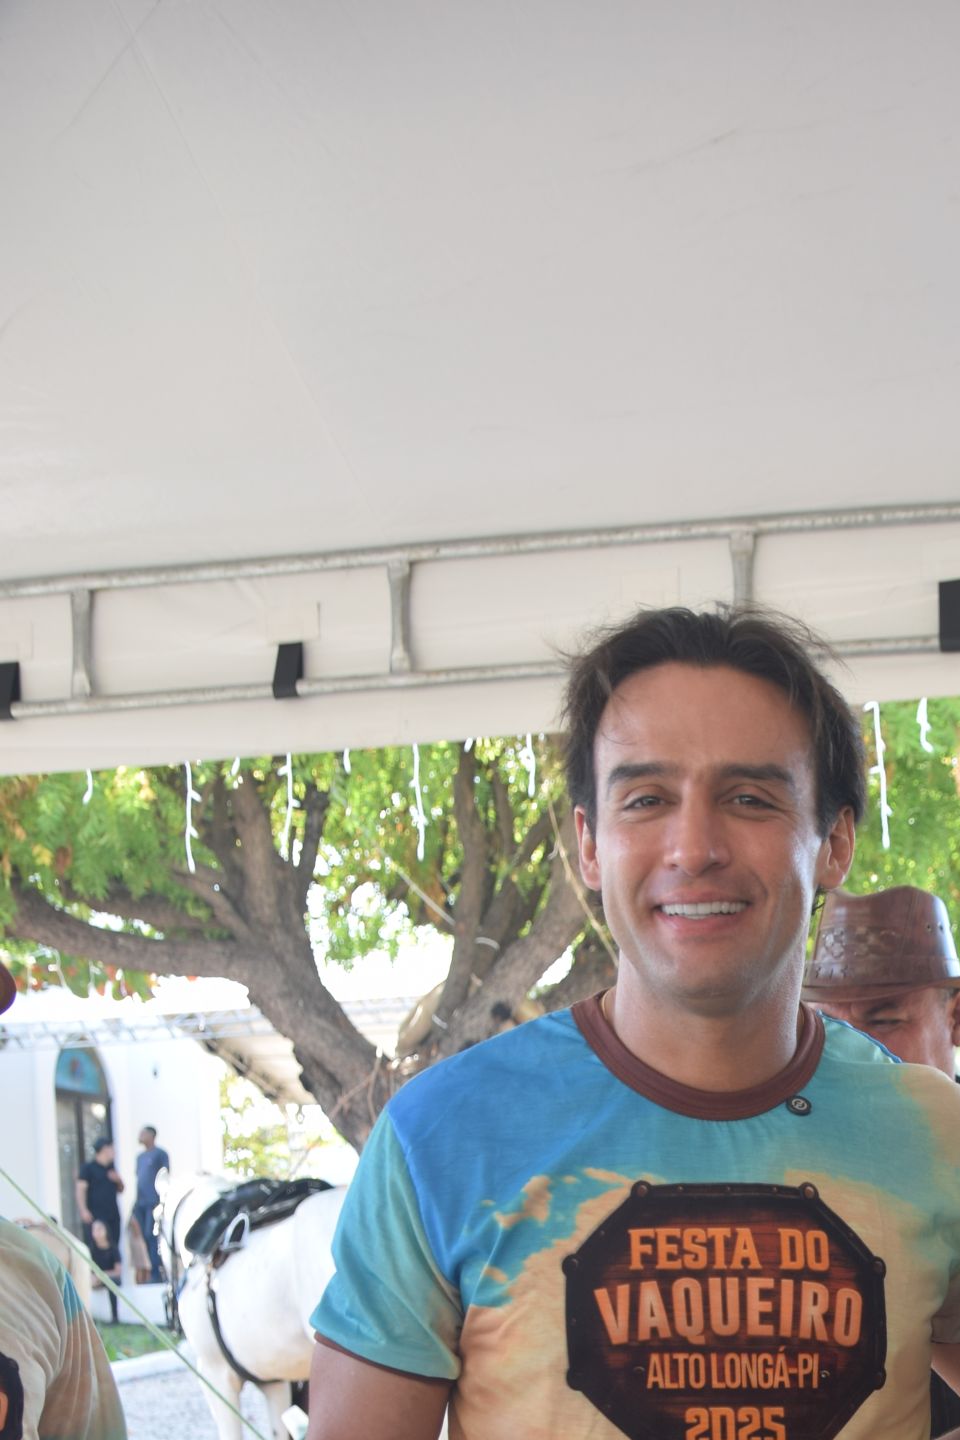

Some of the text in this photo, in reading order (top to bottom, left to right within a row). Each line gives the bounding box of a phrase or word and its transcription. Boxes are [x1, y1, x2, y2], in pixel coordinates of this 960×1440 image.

[628, 1228, 830, 1271] FESTA DO
[594, 1277, 863, 1347] VAQUEIRO
[647, 1346, 819, 1389] ALTO LONGÁ-PI
